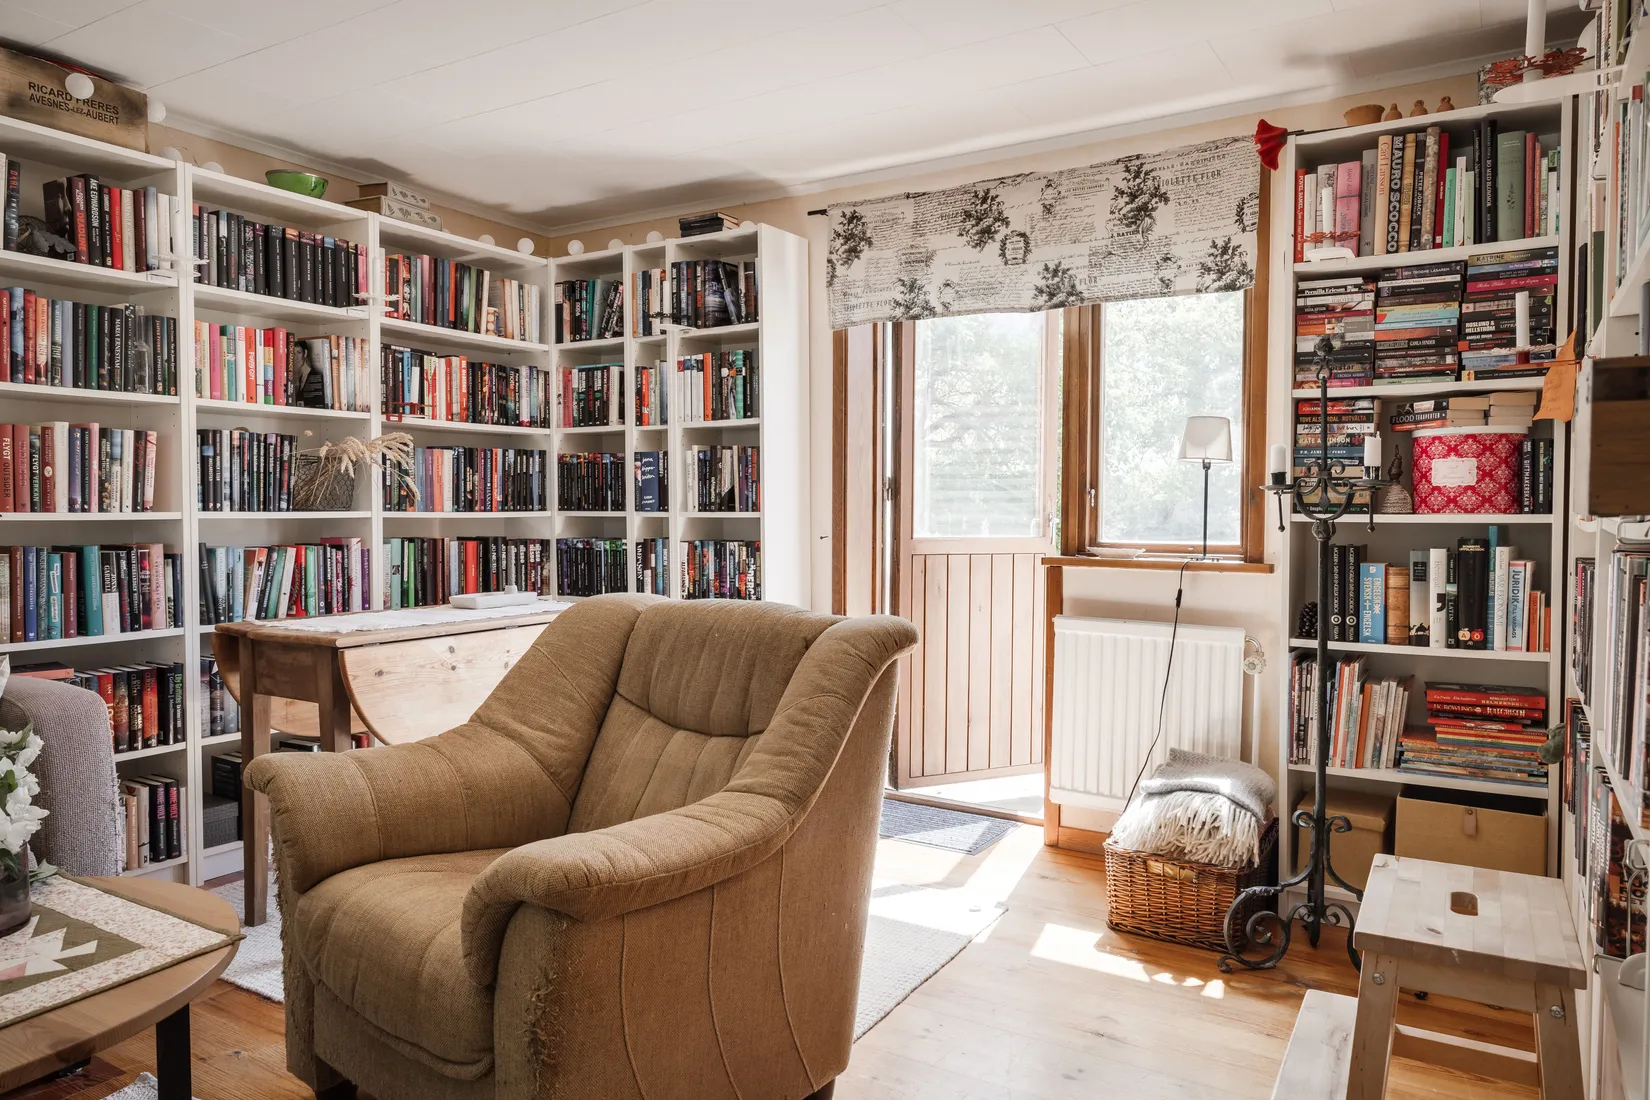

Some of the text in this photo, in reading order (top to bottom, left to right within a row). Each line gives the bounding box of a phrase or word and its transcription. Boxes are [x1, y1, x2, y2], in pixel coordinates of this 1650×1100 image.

[28, 82, 72, 102] RICARD
[29, 93, 120, 125] AVESNES-LEZ-AUBERT
[1378, 142, 1390, 196] Carl Larsson
[90, 178, 99, 189] ÅKE
[1388, 136, 1404, 252] MAURO SCOCCO
[90, 190, 99, 227] EDWARDSON
[77, 212, 86, 252] DEADLINE
[1476, 254, 1505, 262] KATRINE
[1326, 286, 1345, 294] Ericson
[1392, 414, 1414, 423] FLOOD
[1316, 436, 1350, 444] AINSON
[1374, 577, 1382, 604] ENGELSK
[1511, 570, 1522, 604] JURIDIK
[1363, 577, 1372, 636] SVENSK ENGELSK
[1496, 589, 1504, 626] EKONOMI
[1443, 704, 1473, 712] ROWLING
[1486, 706, 1526, 716] JULGRISEN
[157, 788, 165, 804] ANNE
[170, 788, 178, 818] ANNE HOLT
